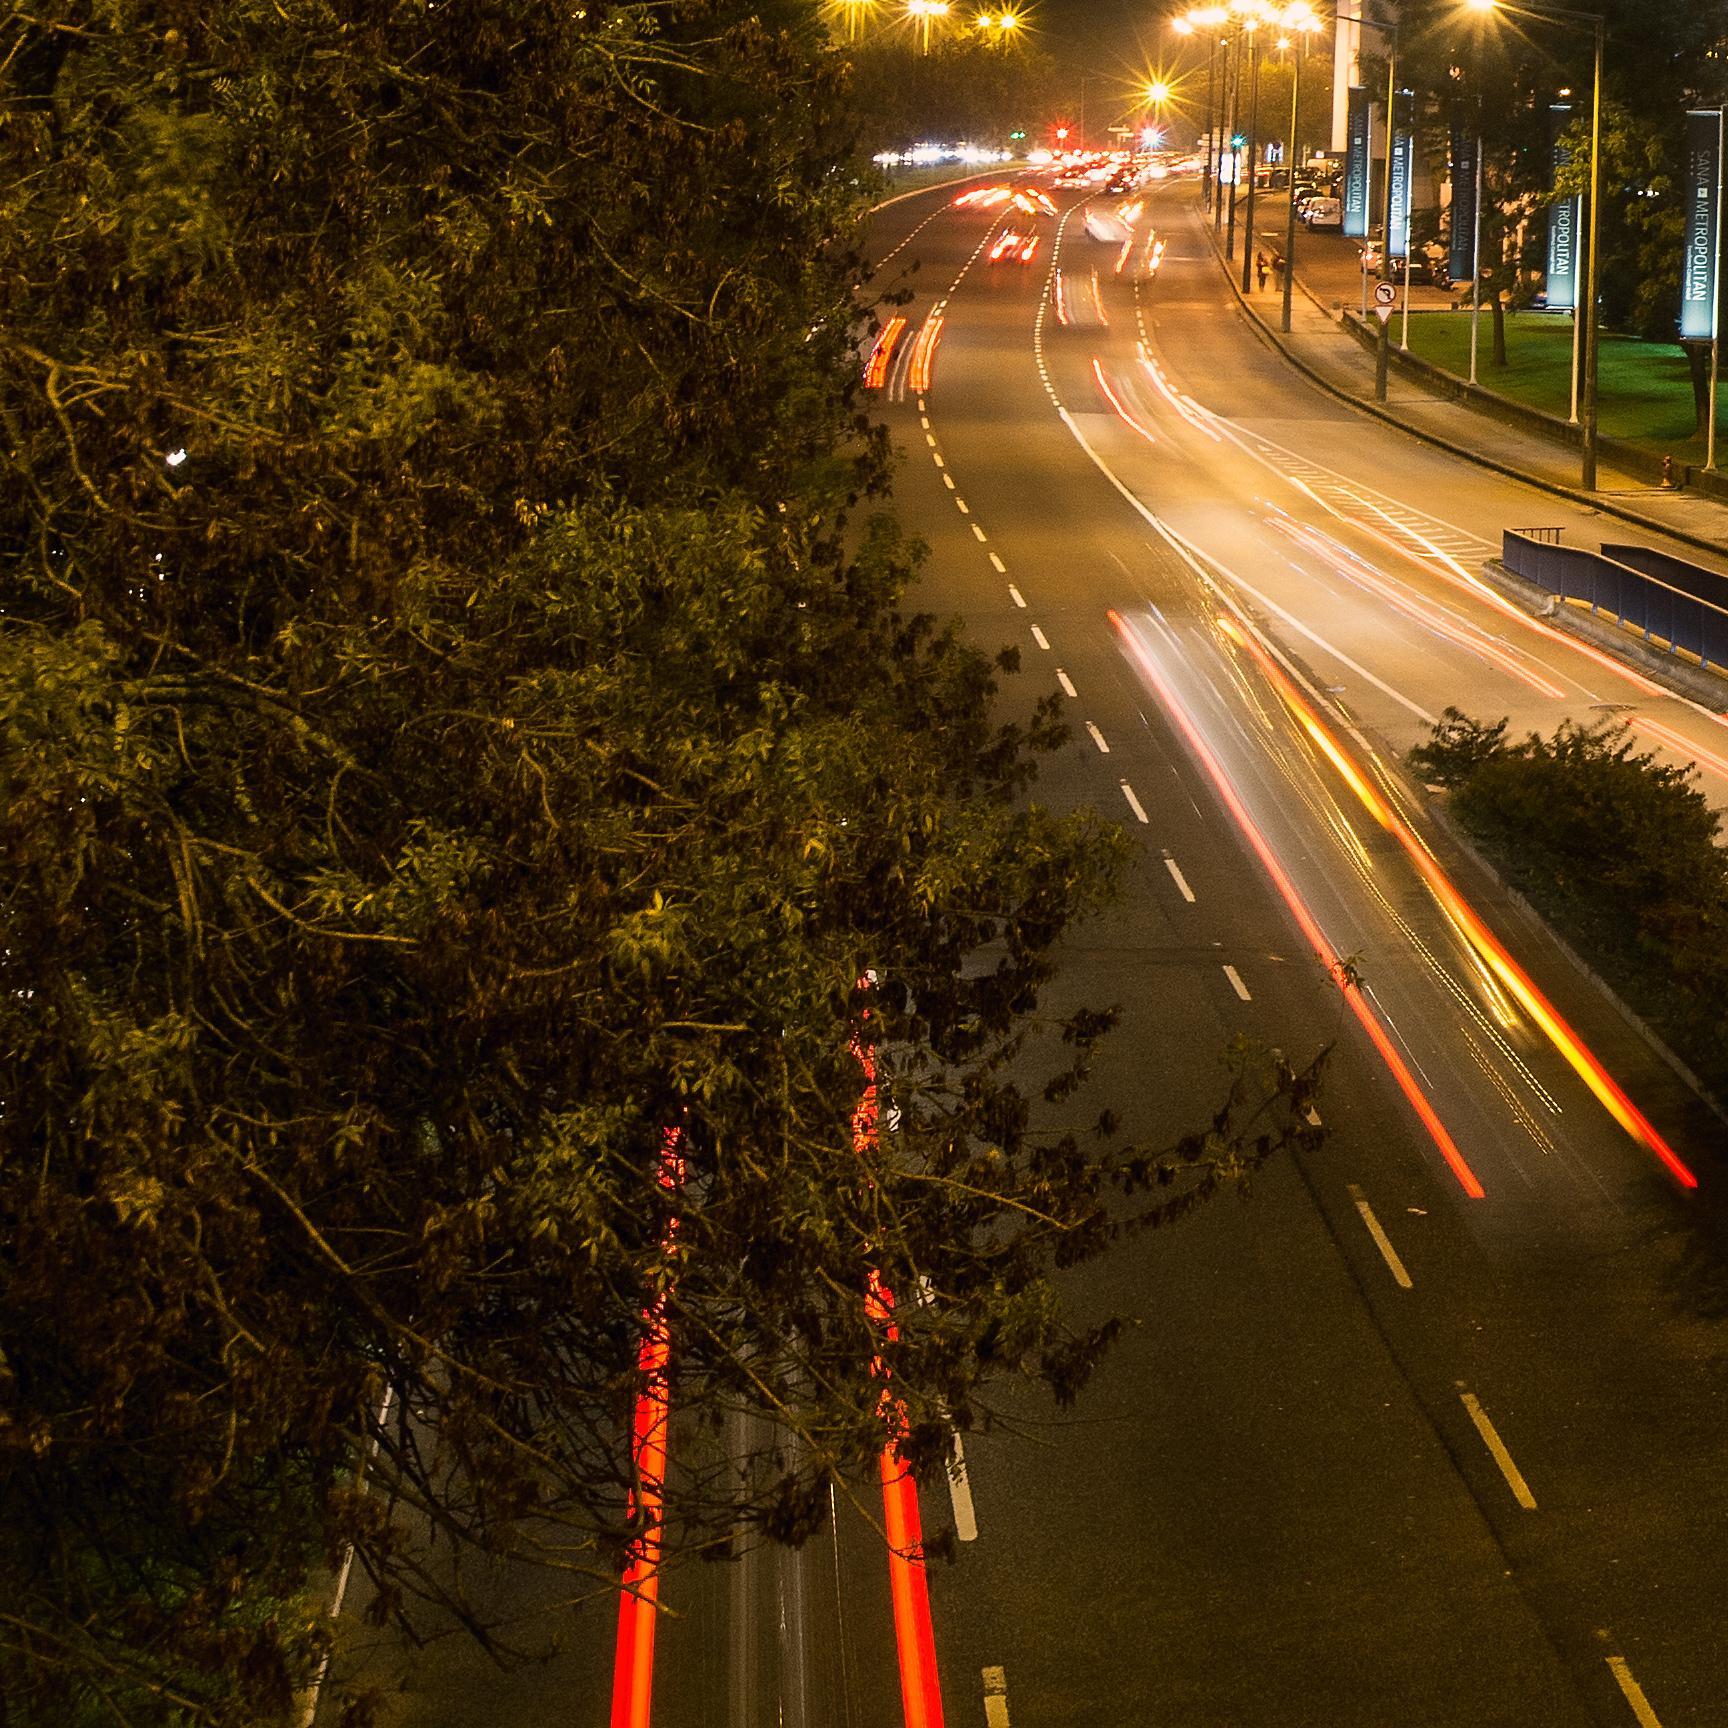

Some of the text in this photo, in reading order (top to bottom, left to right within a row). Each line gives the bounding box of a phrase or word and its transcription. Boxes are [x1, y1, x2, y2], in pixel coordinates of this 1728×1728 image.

[1351, 146, 1362, 213] METROPOLITAN
[1390, 157, 1404, 229] METROPOLITAN
[1692, 151, 1710, 301] SANA METROPOLITAN
